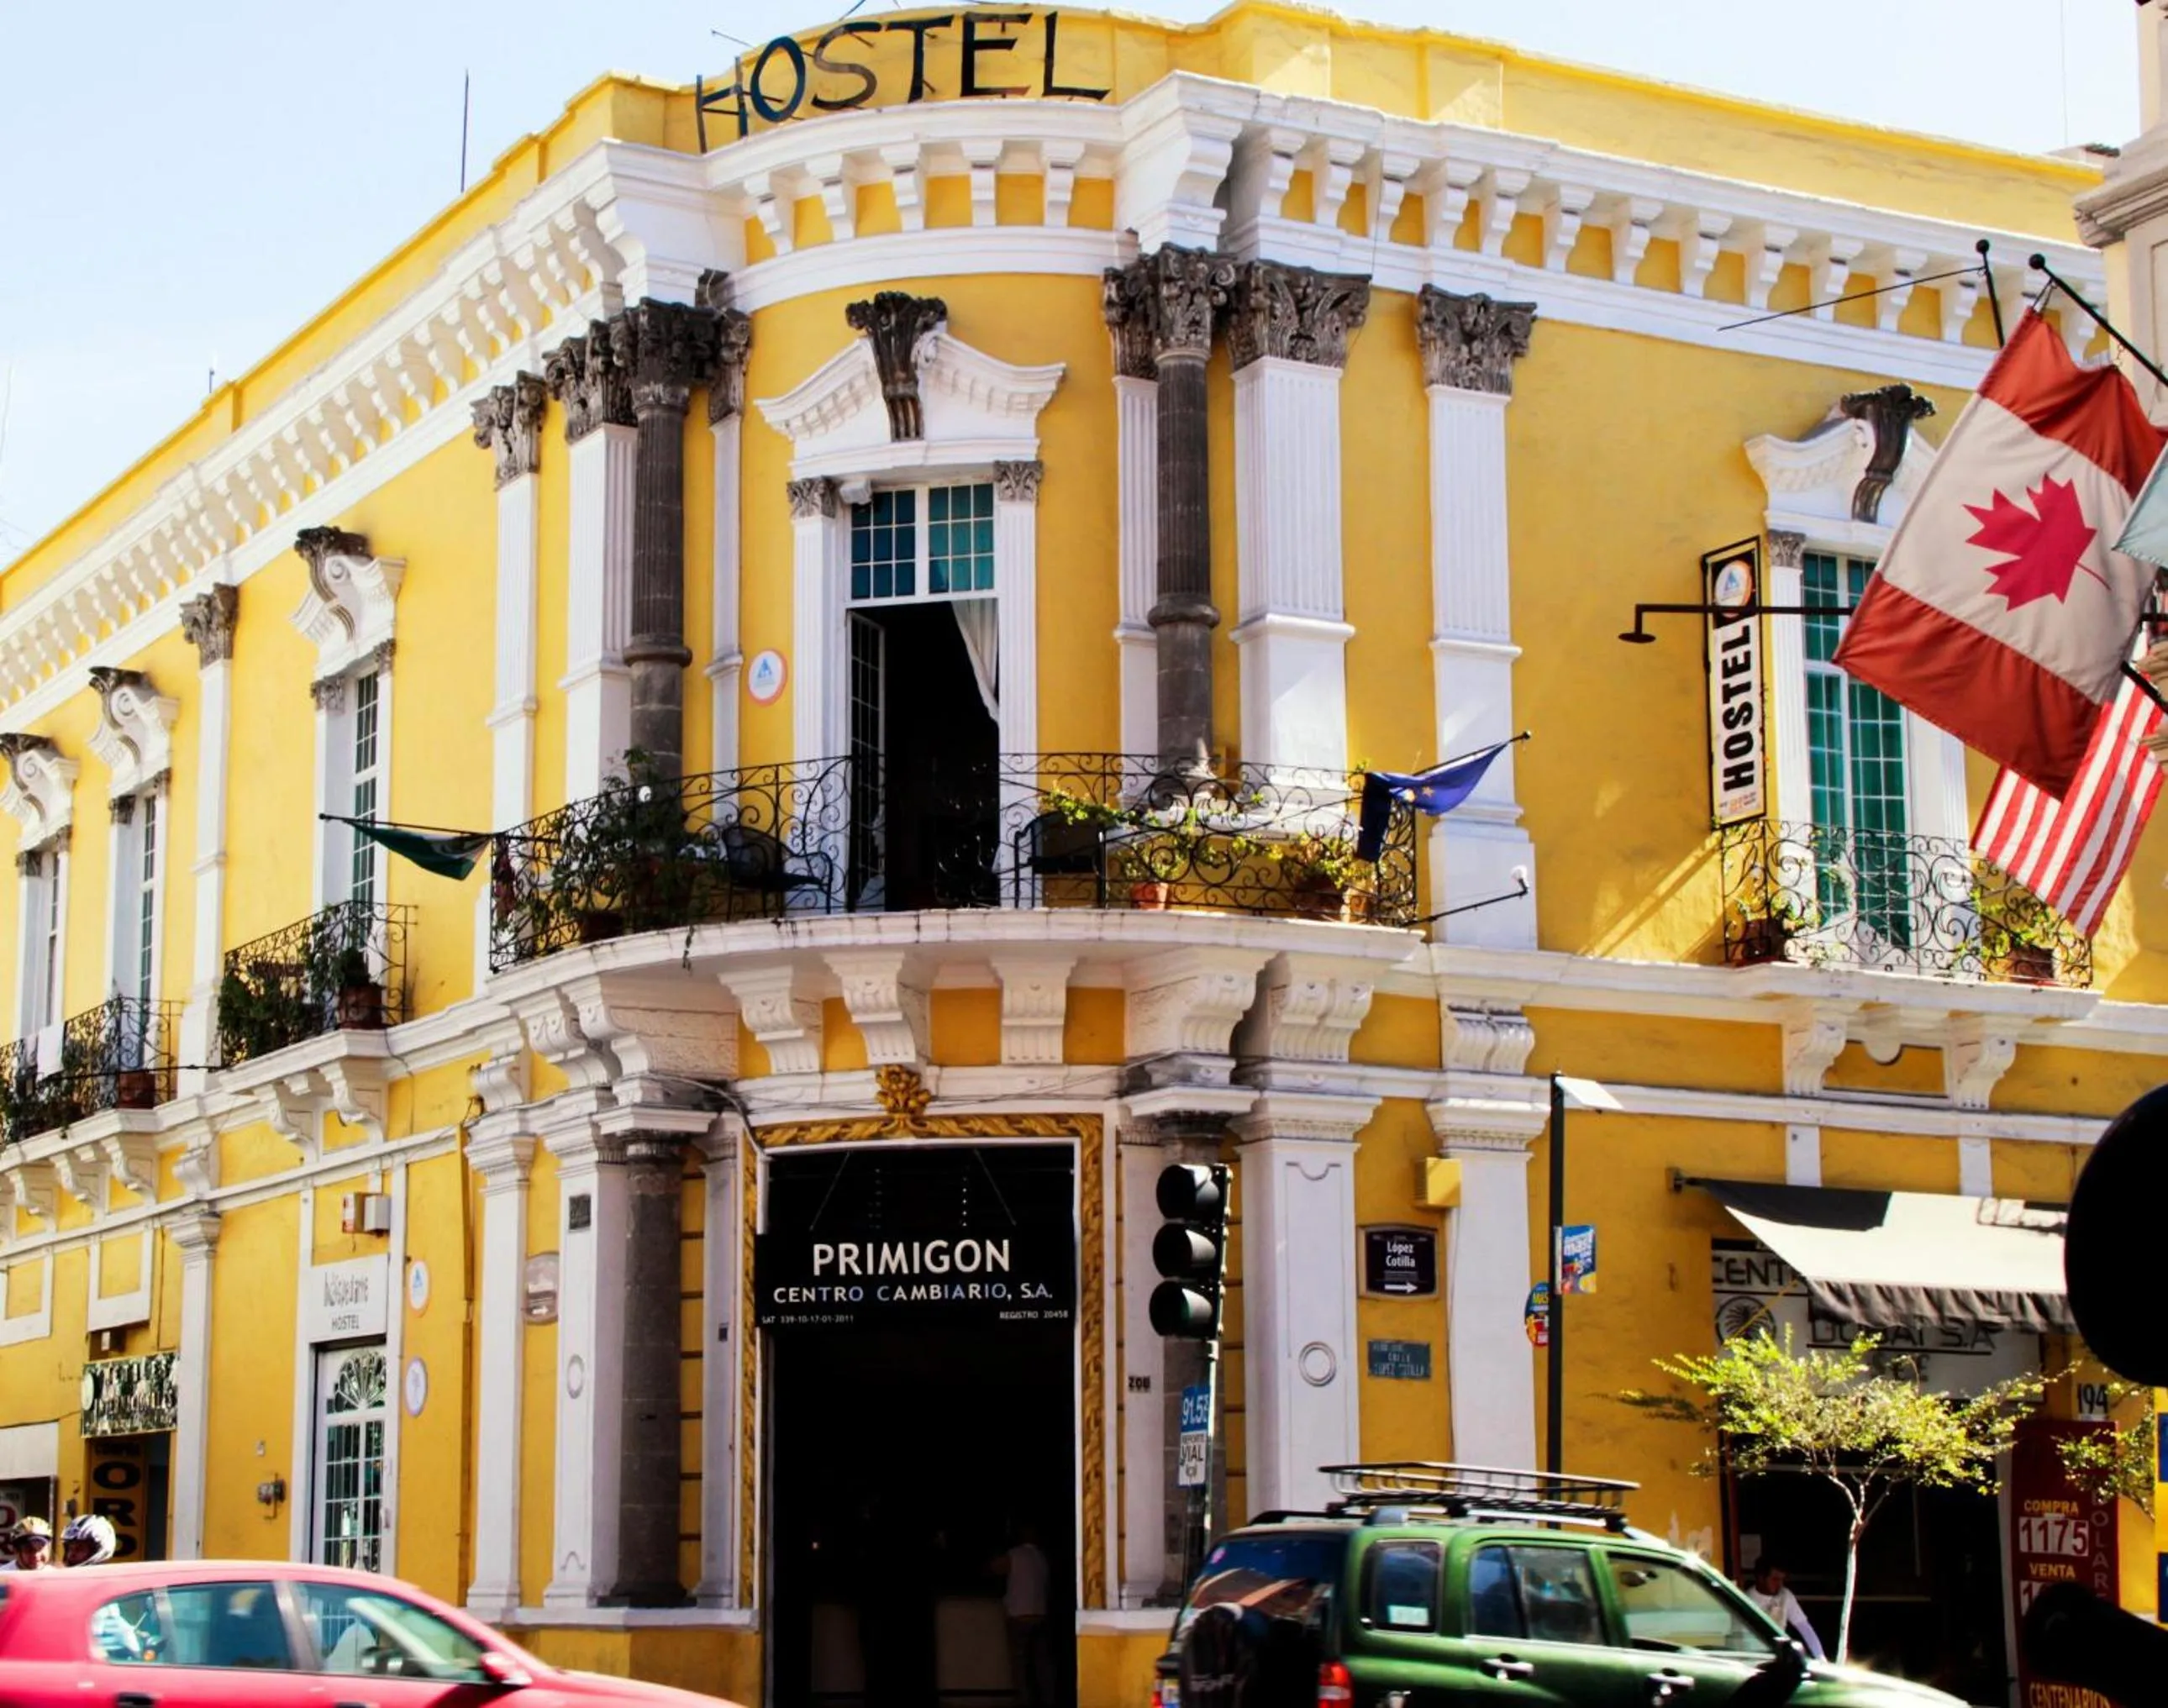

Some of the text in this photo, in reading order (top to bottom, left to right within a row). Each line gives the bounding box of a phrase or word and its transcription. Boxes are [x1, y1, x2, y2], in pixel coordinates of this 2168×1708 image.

[696, 11, 1111, 153] HOSTEL
[1722, 624, 1755, 792] HOSTEL
[813, 1238, 1010, 1276] PRIMIGON
[1387, 1241, 1414, 1255] López
[1385, 1255, 1416, 1267] Cotilla
[773, 1282, 1053, 1303] CENTRO CAMBIARIO, S.A.
[332, 1314, 360, 1330] HOSTEL
[999, 1311, 1039, 1319] REGISTRO
[2078, 1383, 2108, 1414] 194
[2024, 1500, 2079, 1514] COMPRA
[2021, 1518, 2087, 1555] 1175
[2029, 1563, 2076, 1579] VENTA
